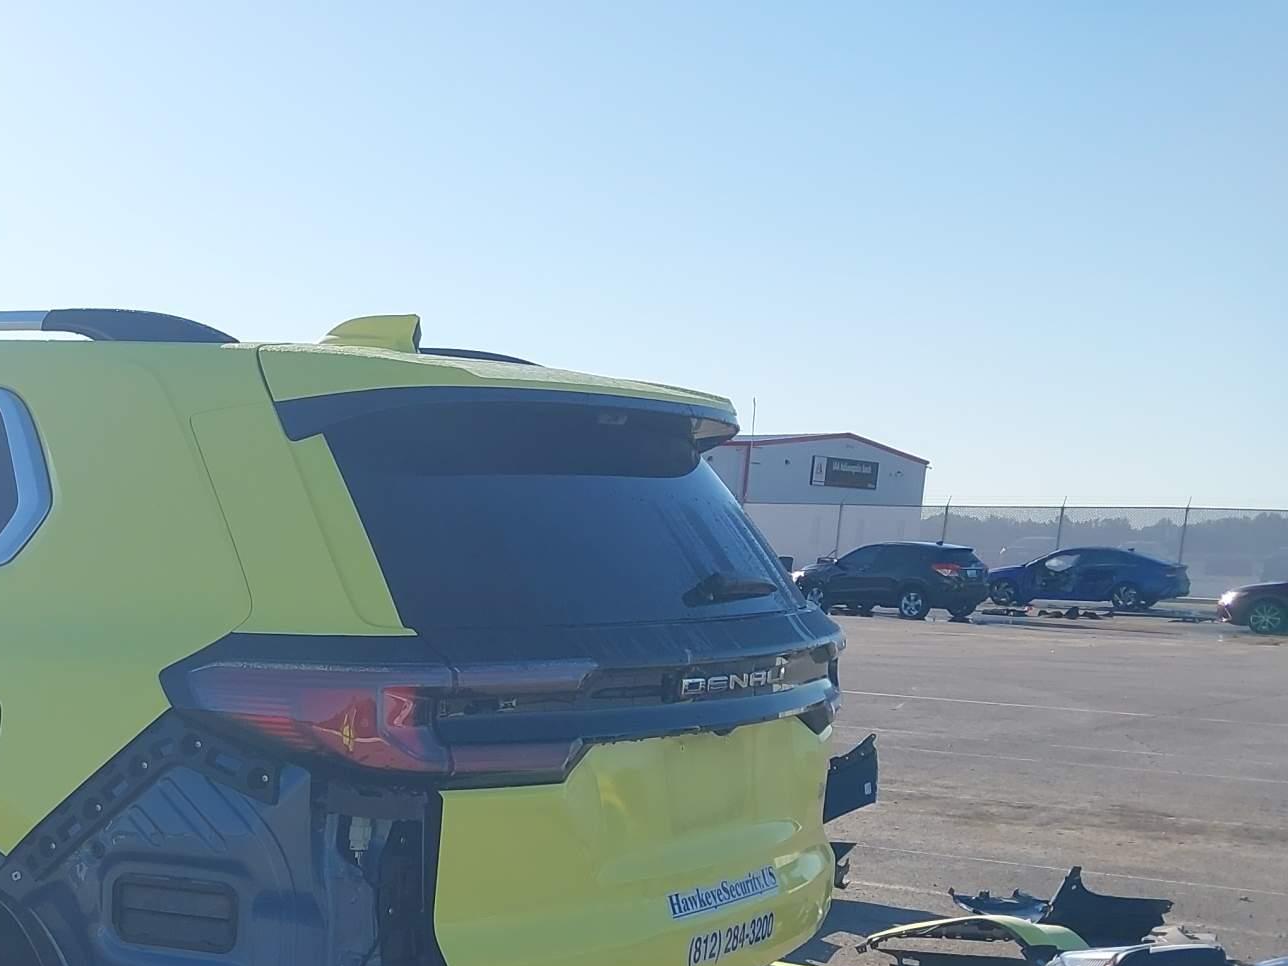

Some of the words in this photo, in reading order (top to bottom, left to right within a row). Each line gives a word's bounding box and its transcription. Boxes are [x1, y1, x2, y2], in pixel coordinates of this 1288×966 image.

[681, 667, 785, 696] DENALI
[668, 866, 778, 917] HawkeyeSecurity.US
[724, 912, 774, 954] 284-3200
